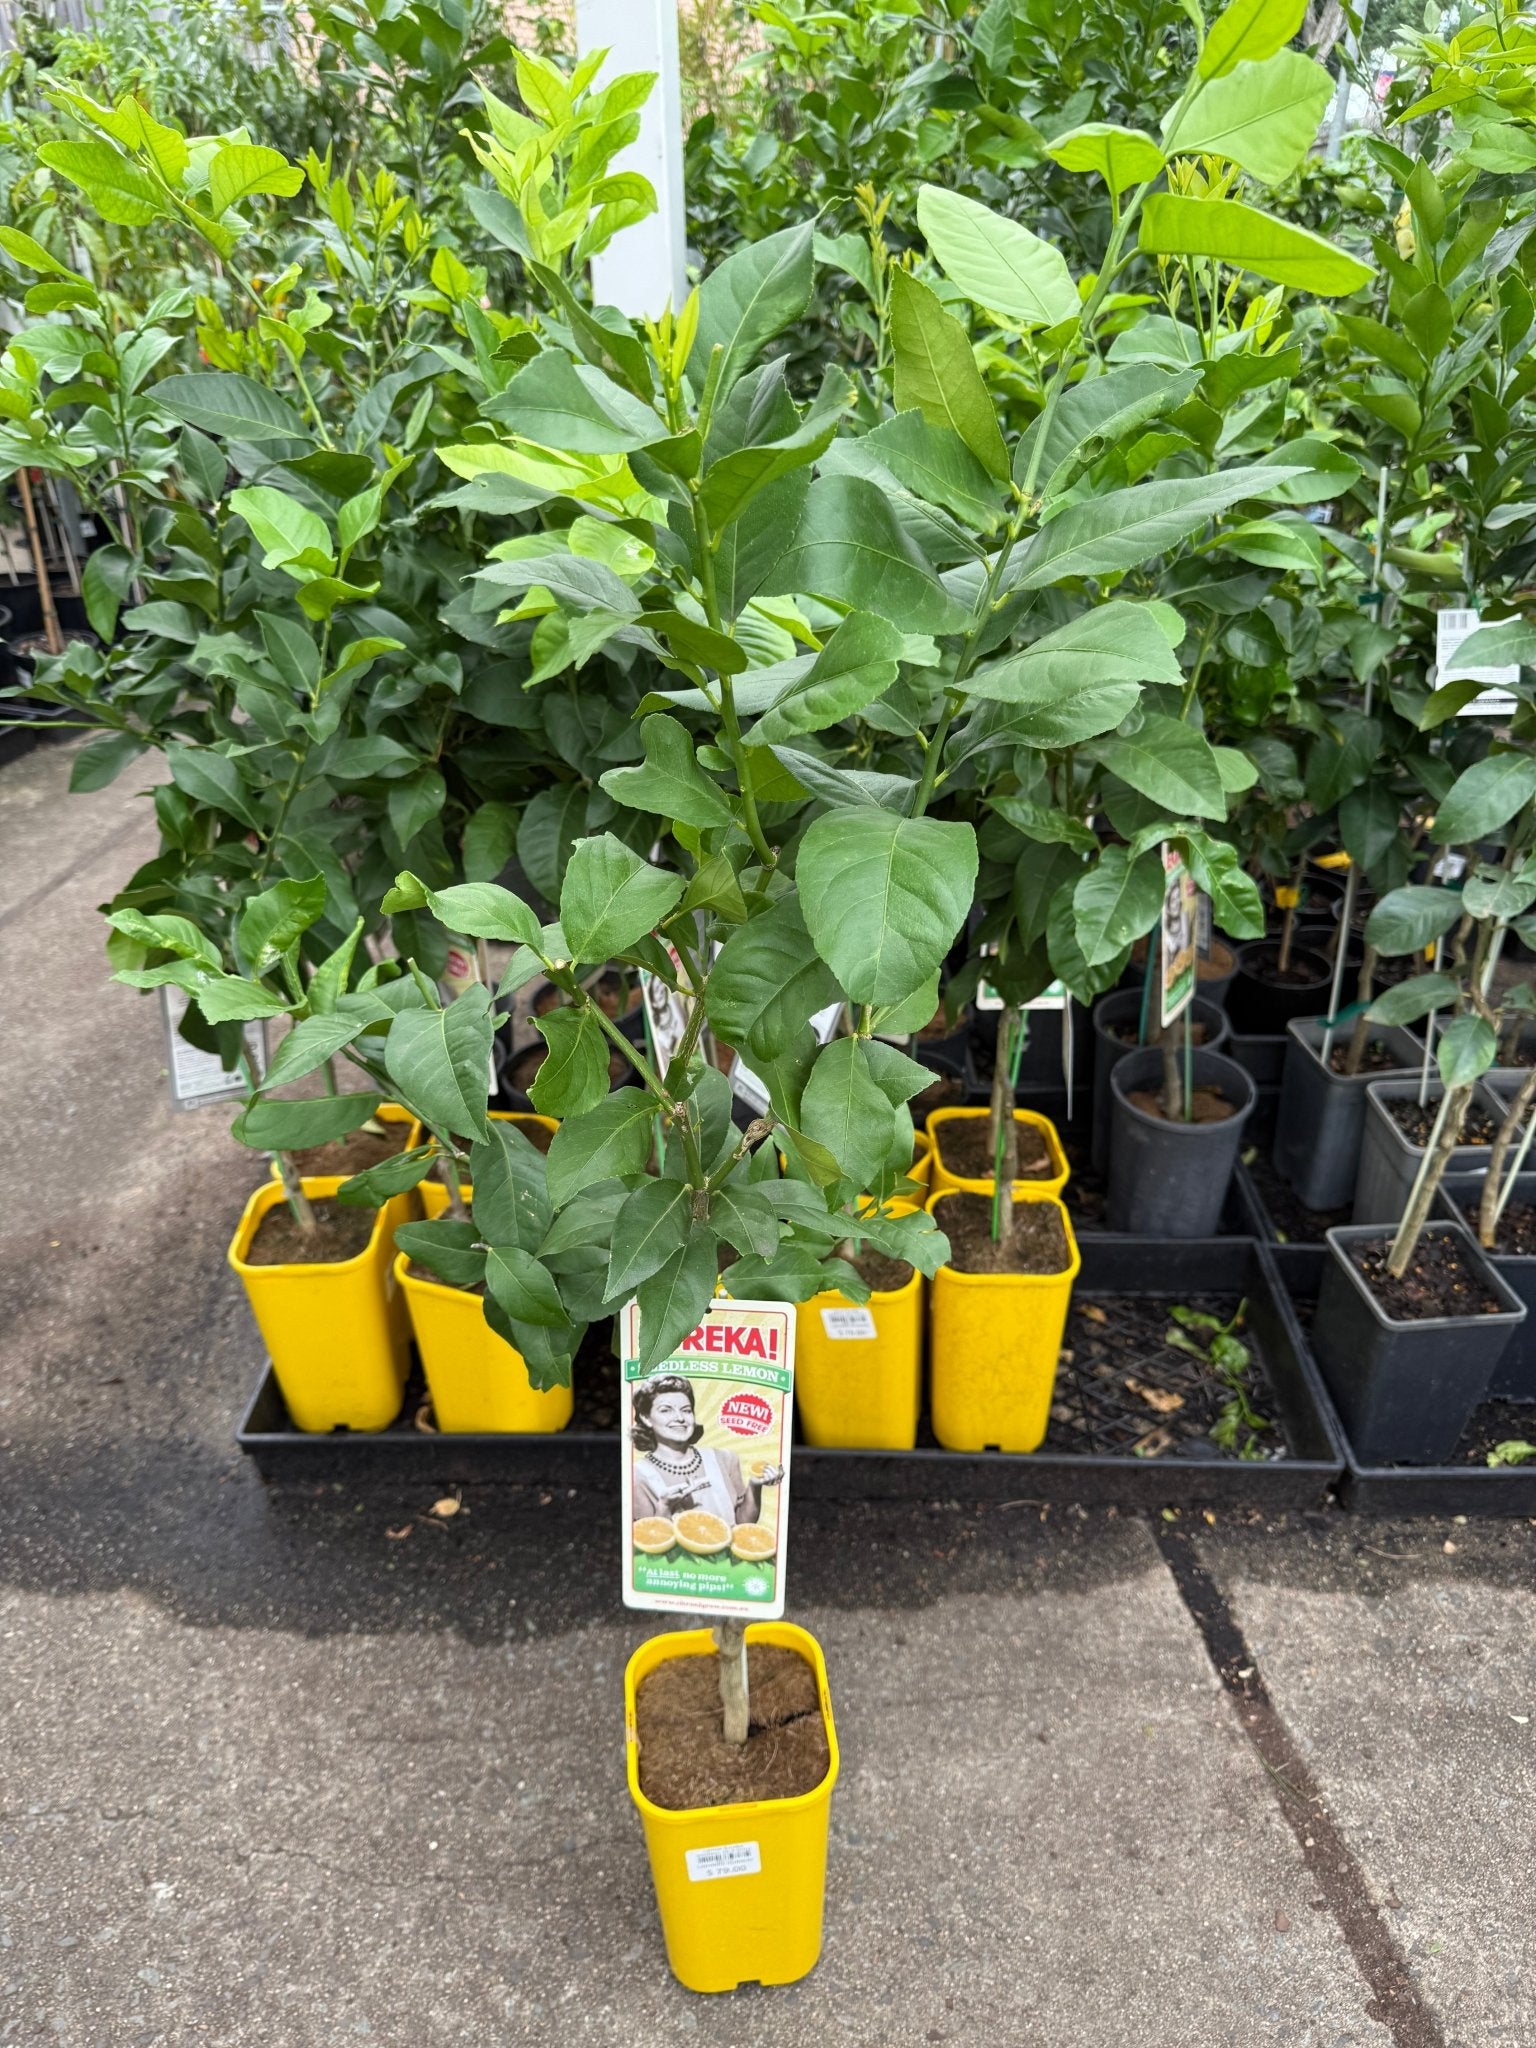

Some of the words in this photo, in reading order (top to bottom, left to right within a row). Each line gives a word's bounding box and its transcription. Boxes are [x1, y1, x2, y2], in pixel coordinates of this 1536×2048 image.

[683, 1325, 778, 1361] REKA!
[638, 1360, 719, 1373] EDLESS
[719, 1363, 780, 1383] LEMON
[728, 1401, 769, 1421] NEW!
[720, 1417, 744, 1425] SEED
[746, 1420, 769, 1433] FREE
[646, 1577, 697, 1591] annoying
[659, 1568, 681, 1579] last
[682, 1571, 696, 1580] no
[697, 1574, 727, 1582] more
